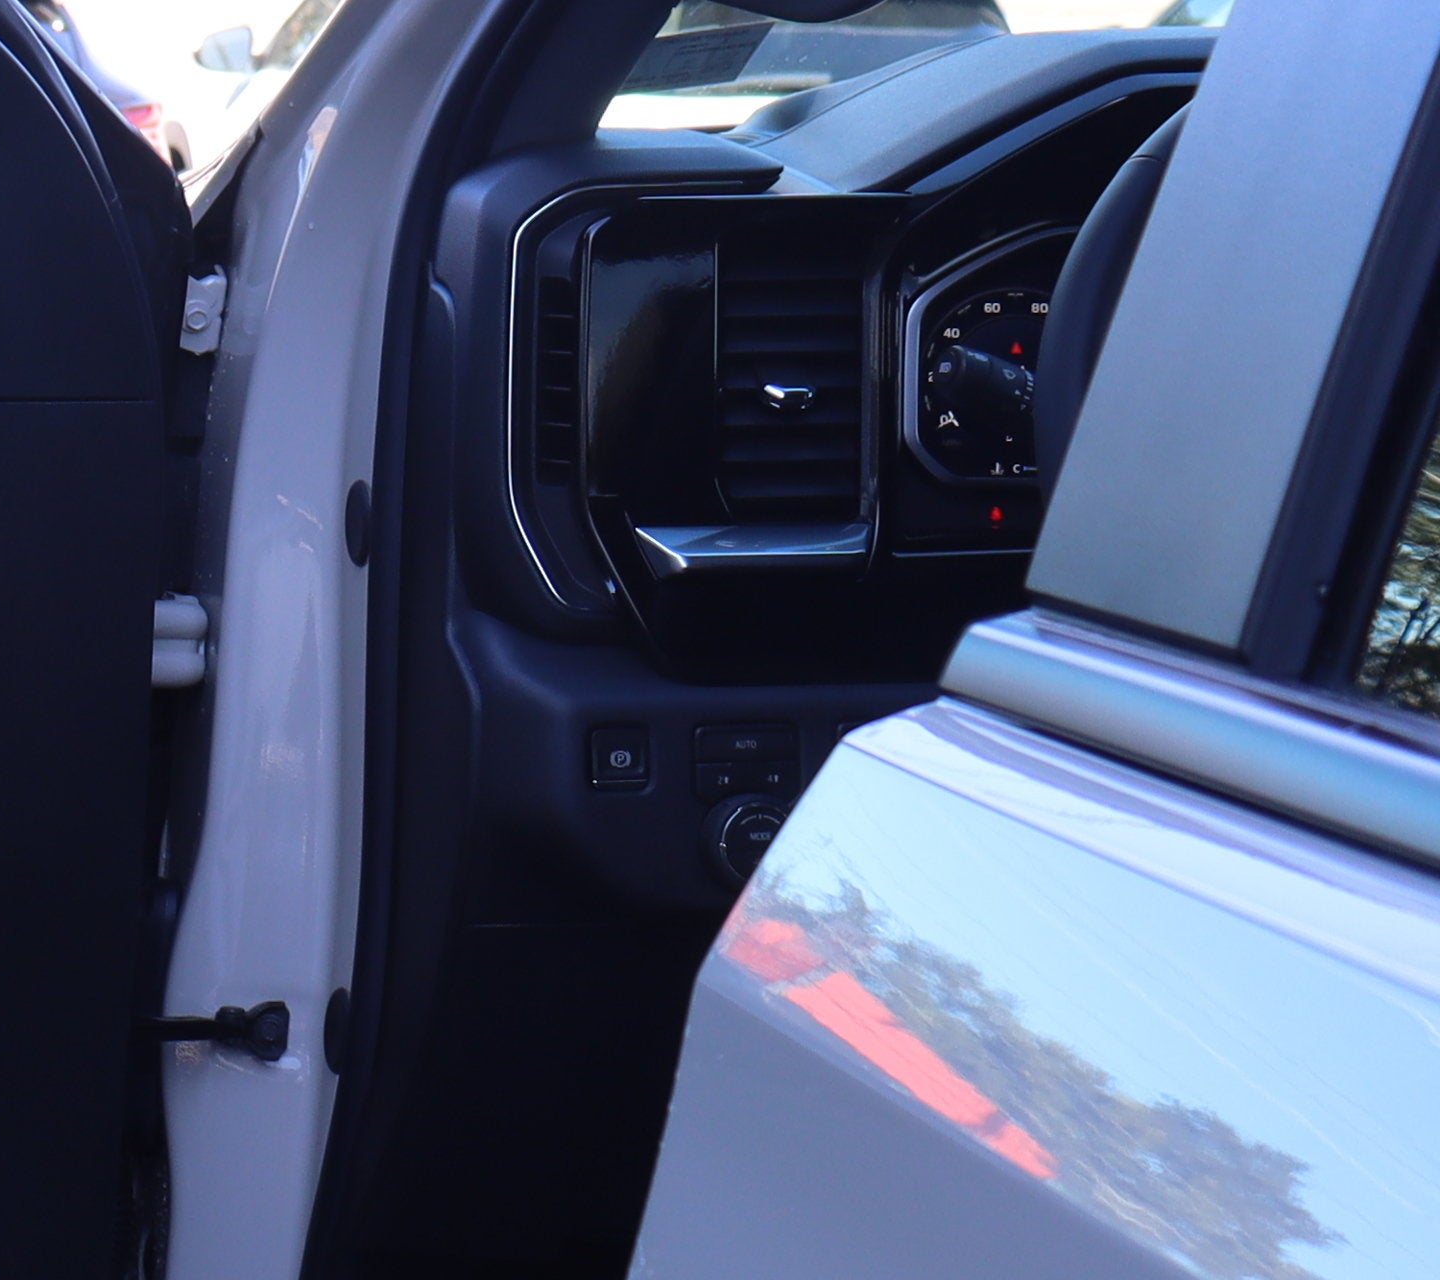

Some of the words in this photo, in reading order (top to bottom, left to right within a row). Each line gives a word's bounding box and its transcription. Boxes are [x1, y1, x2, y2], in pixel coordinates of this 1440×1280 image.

[983, 302, 1001, 313] 60
[1030, 302, 1049, 313] 80
[943, 327, 960, 339] 40
[735, 740, 758, 749] AUTO
